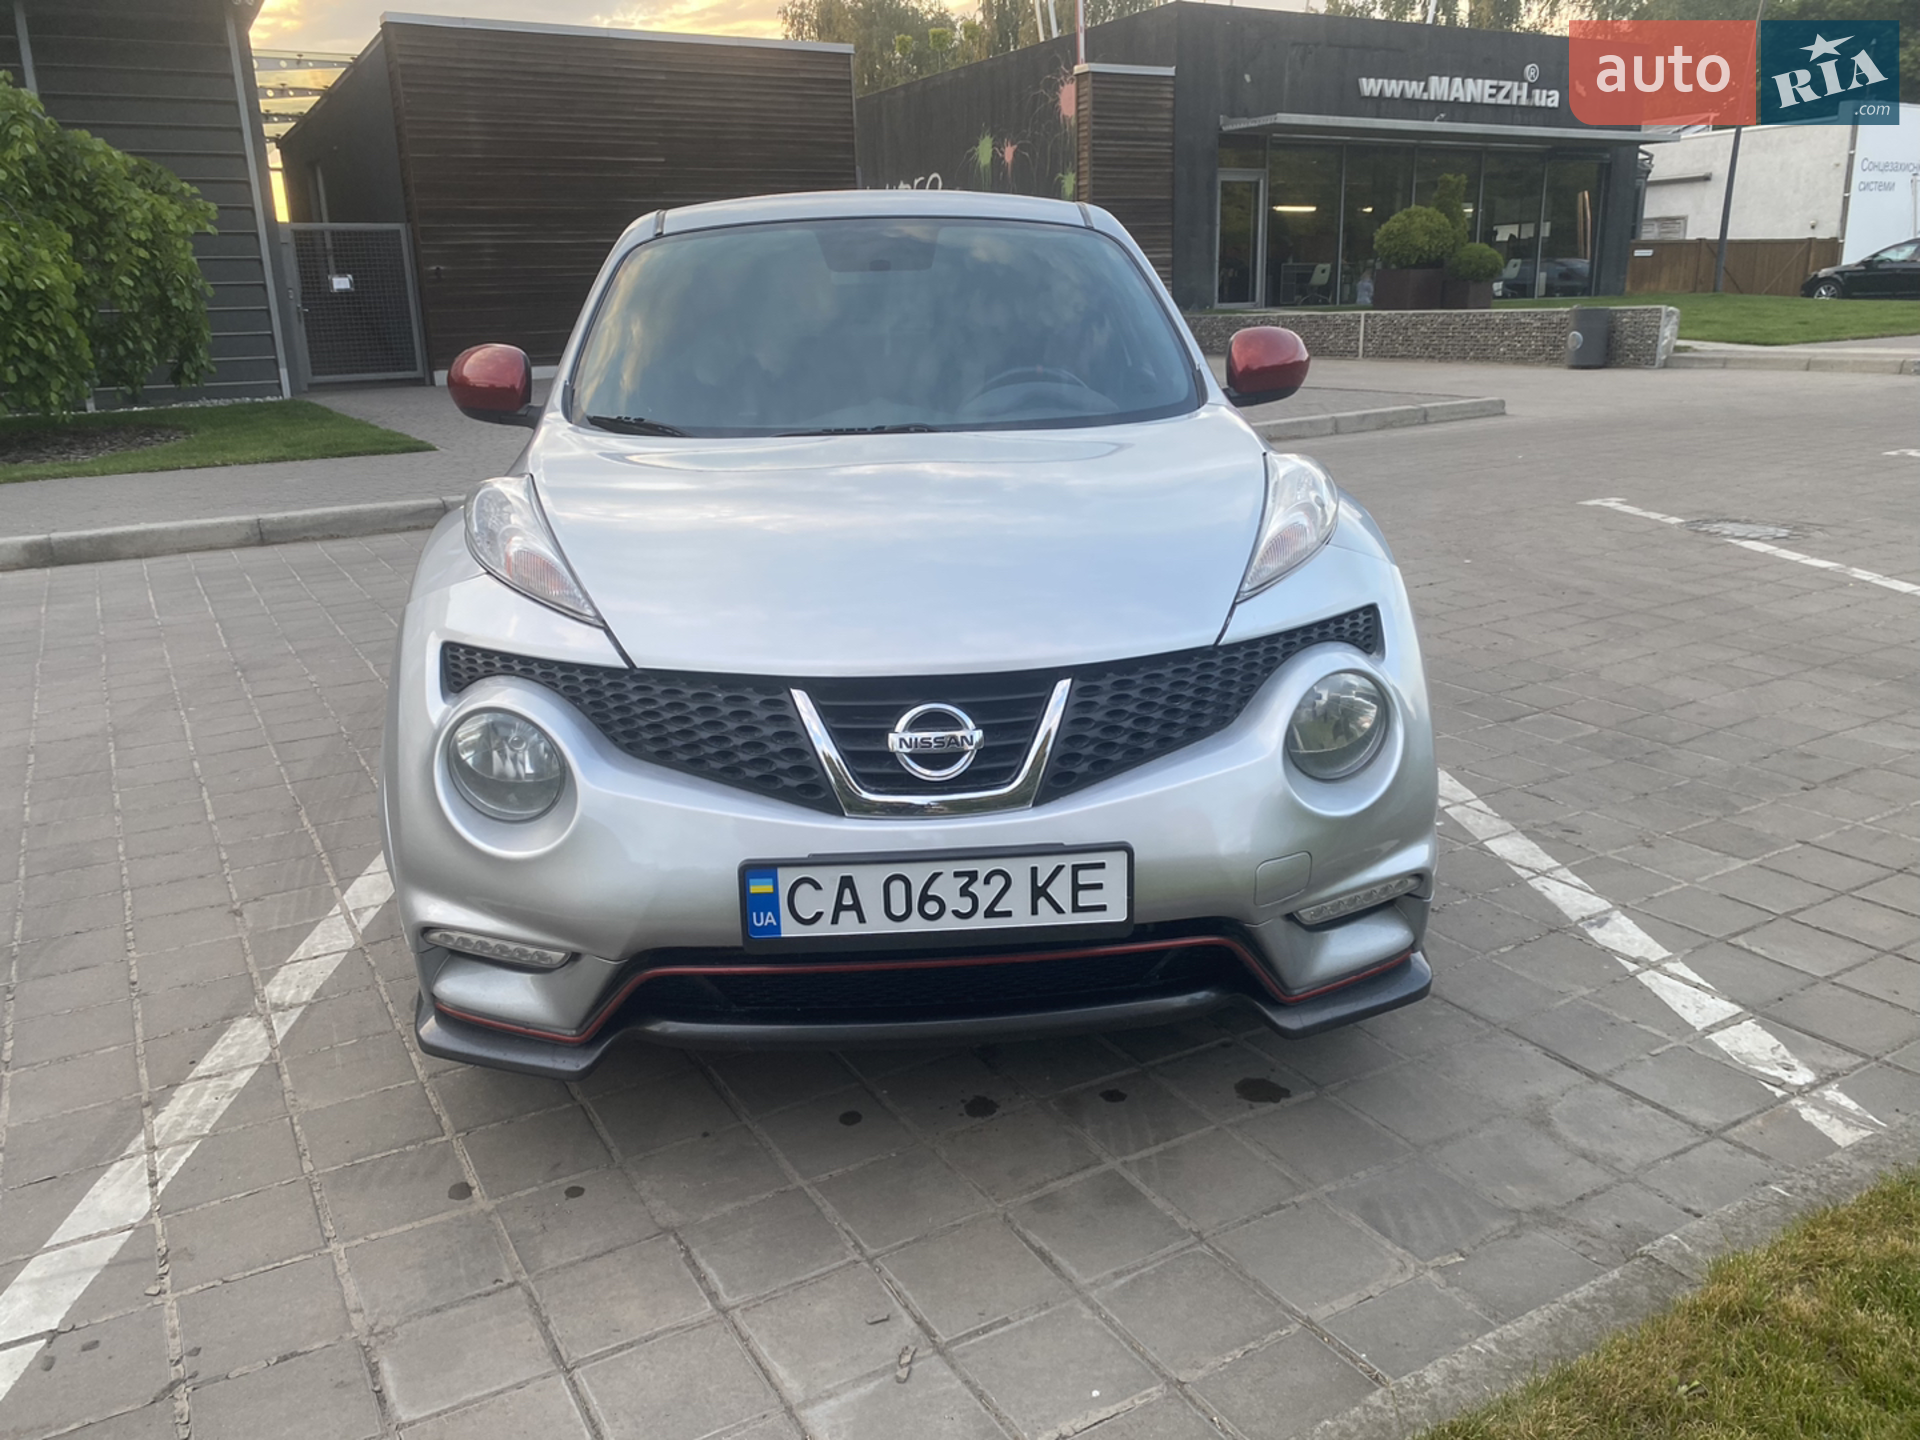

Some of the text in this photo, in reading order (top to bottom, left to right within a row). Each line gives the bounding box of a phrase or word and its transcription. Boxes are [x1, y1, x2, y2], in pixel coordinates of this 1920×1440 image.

[898, 734, 975, 750] NISSAN
[786, 861, 1108, 926] CA 0632 KE
[751, 910, 778, 927] UA
